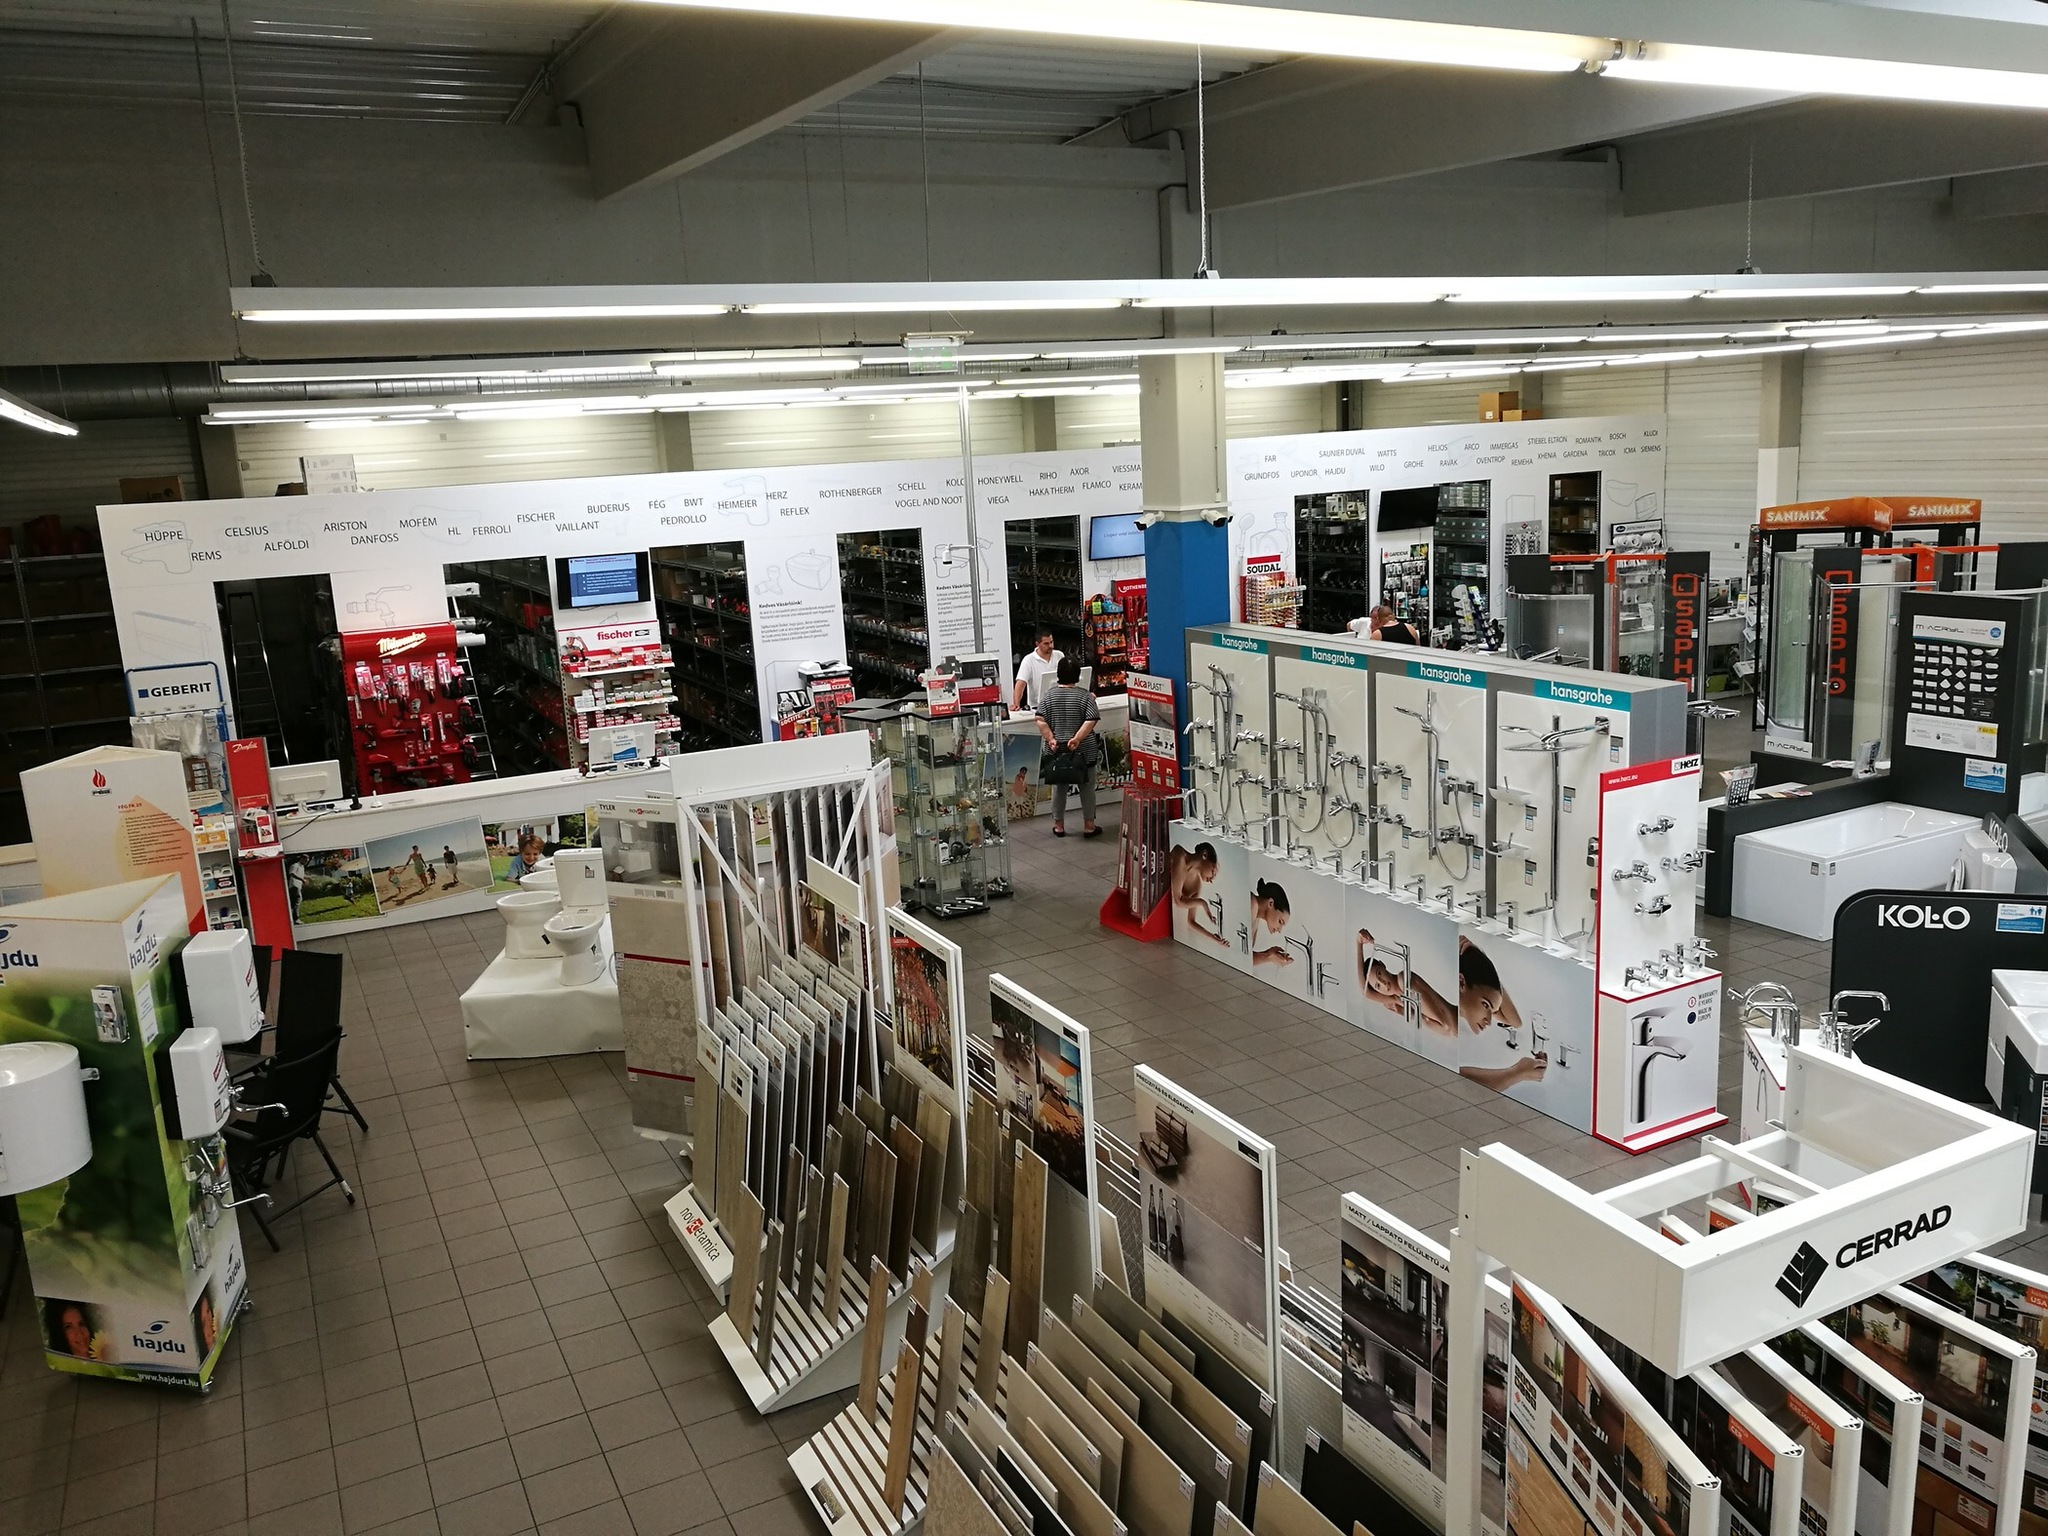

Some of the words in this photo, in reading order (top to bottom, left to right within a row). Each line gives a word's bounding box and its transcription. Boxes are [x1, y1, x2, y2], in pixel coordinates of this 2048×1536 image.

[1548, 436, 1568, 444] ELTRON
[1490, 442, 1519, 450] IMMERGAS
[1640, 445, 1662, 453] SIEMENS
[1319, 450, 1344, 458] SAUNIER
[1346, 448, 1365, 456] DUVAL
[1377, 450, 1397, 458] WATTS
[1563, 450, 1588, 458] GARDENA
[1404, 460, 1424, 468] GROHE
[1476, 456, 1505, 464] OVENTROP
[1511, 458, 1533, 466] REMEHA
[1070, 467, 1089, 476] AXOR
[1291, 469, 1318, 478] UPONOR
[1325, 468, 1346, 476] HAJDU
[1369, 464, 1385, 472] WILO
[978, 475, 1023, 486] HONEYWELL
[1040, 471, 1057, 480] RIHO
[1244, 471, 1280, 481] GRUNDFOS
[898, 482, 926, 492] SCHELL
[1082, 480, 1111, 490] FLAMCO
[766, 491, 787, 501] HERZ
[819, 487, 882, 499] ROTHENBERGER
[1029, 488, 1049, 497] HAKA
[1050, 486, 1075, 496] THERM
[648, 498, 666, 510] FÉG
[684, 497, 704, 507] BWT
[717, 499, 757, 510] HEIMEIER
[895, 498, 920, 508] VOGEL
[922, 497, 939, 506] AND
[941, 495, 963, 505] NOOT
[988, 495, 1009, 505] VIEGA
[587, 503, 630, 514] BUDERUS
[780, 507, 810, 517] REFLEX
[1908, 500, 1975, 517] SANIMIX
[517, 512, 555, 523] FISCHER
[660, 514, 707, 526] PEDROLLO
[1766, 508, 1829, 522] SANIMIX
[324, 520, 367, 532] ARISTON
[399, 517, 437, 529] MOFÉM
[555, 521, 599, 532] VAILLANT
[144, 529, 183, 542] HÜPPE
[225, 525, 269, 537] CELSIUS
[448, 526, 461, 536] HL
[472, 524, 511, 536] FERROLI
[350, 533, 399, 545] DANFOSS
[264, 539, 309, 552] ALFÖLDI
[191, 550, 222, 562] REMS
[1247, 563, 1281, 574] SOUDAL
[597, 630, 633, 641] fischer
[1222, 633, 1258, 650] hansgrohe
[1312, 647, 1355, 666] hansgrohe
[1420, 663, 1472, 684] hansgrohe
[151, 682, 212, 698] GEBERIT
[1551, 682, 1612, 705] hansgrohe
[129, 934, 157, 970] hajdu
[1698, 1013, 1711, 1022] EUROPE
[1348, 1206, 1366, 1220] MATT
[1372, 1220, 1403, 1244] LAPPATO
[1836, 1204, 1952, 1270] CERRAD
[2030, 1296, 2048, 1306] USA
[133, 1335, 186, 1355] hajdu
[138, 1372, 199, 1388] www.hajdurt.hu
